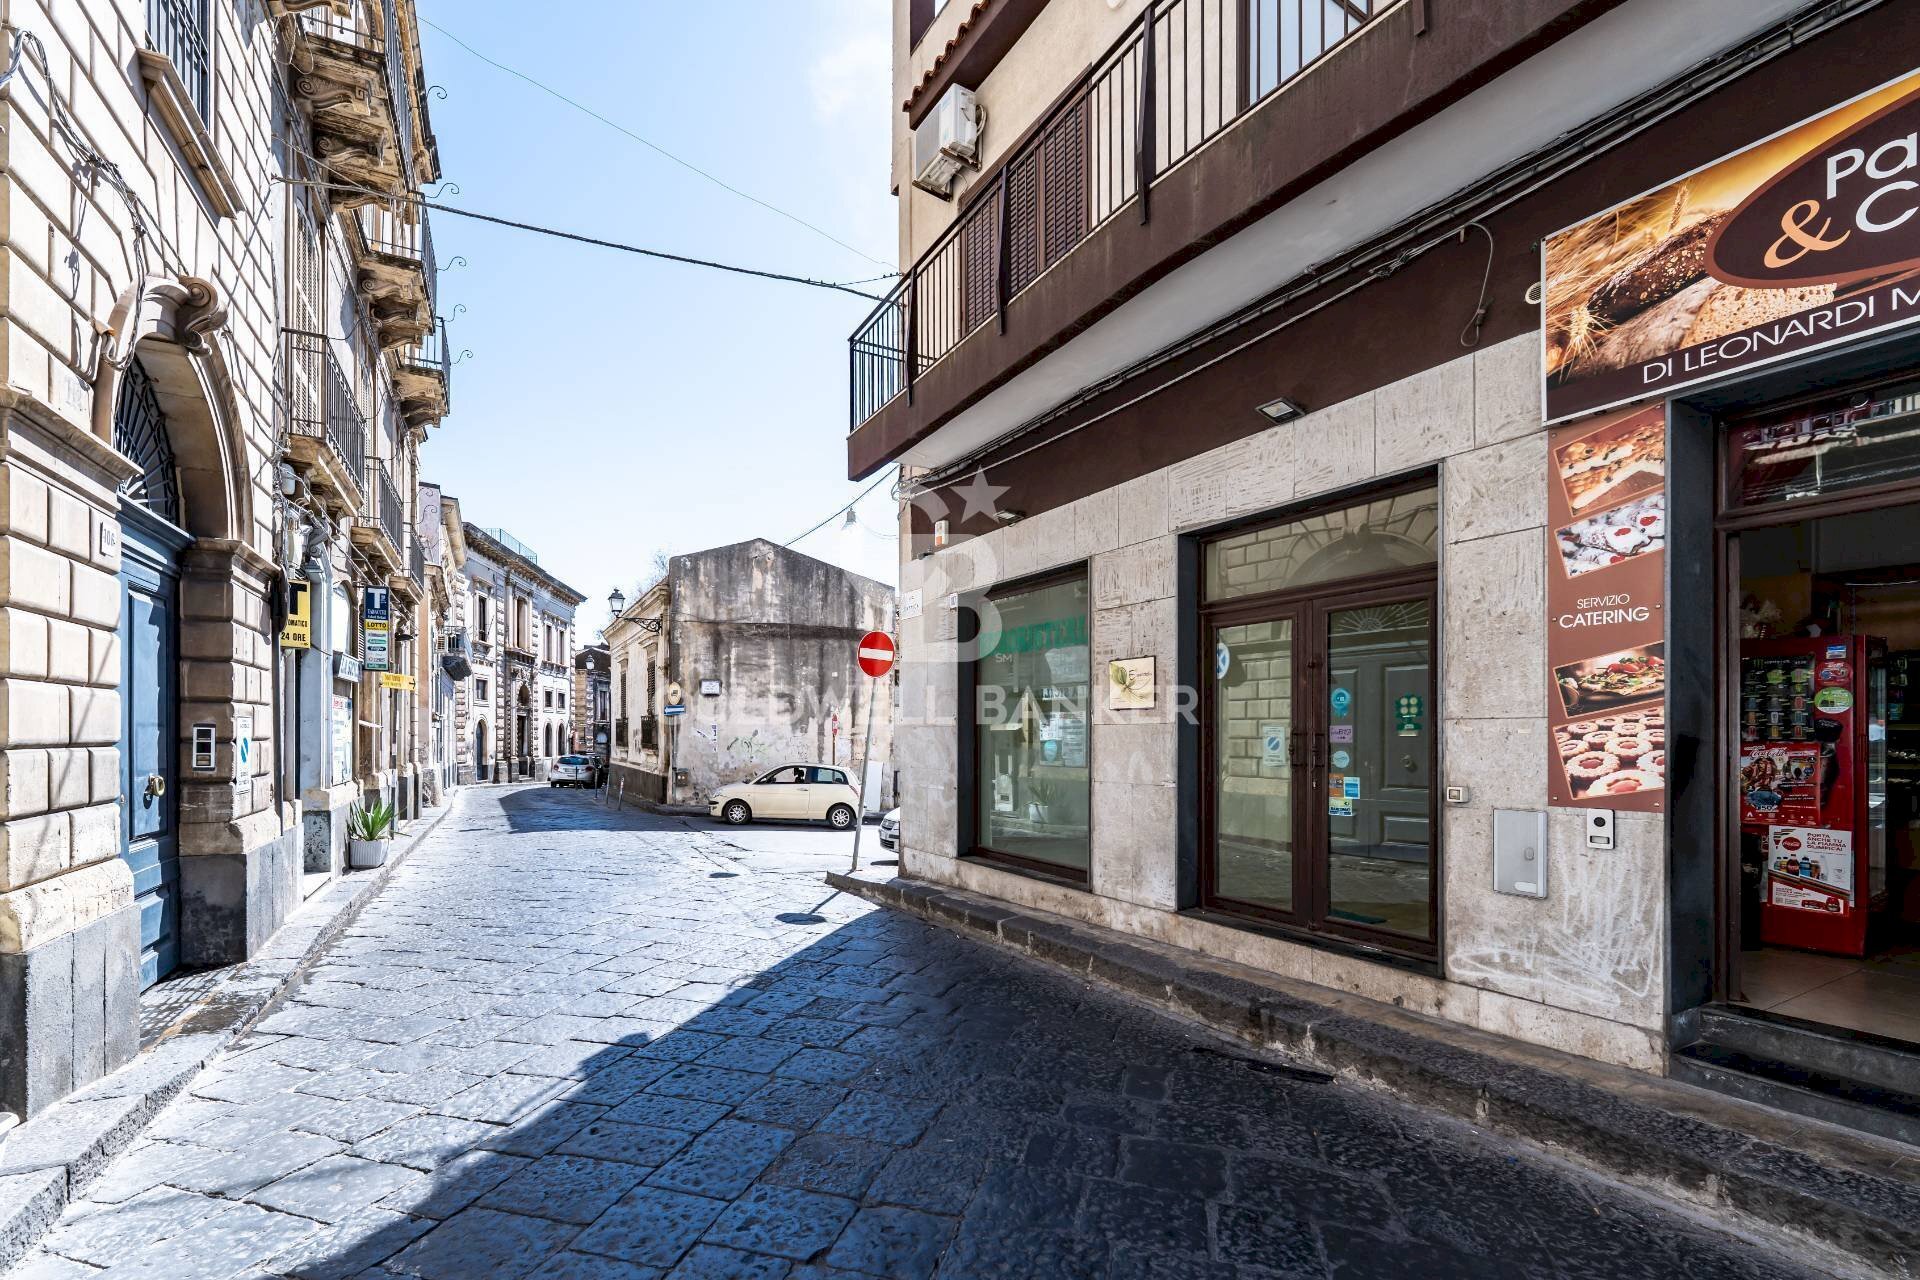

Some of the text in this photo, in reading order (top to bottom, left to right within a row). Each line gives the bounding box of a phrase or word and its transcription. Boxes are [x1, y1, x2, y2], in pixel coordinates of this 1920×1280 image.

[1827, 132, 1918, 200] Pa
[1763, 180, 1920, 269] & C
[1643, 358, 1673, 384] DI
[1685, 295, 1875, 372] LEONARDI
[1577, 593, 1630, 609] SERVIZIO
[287, 619, 308, 628] OMATICO
[1559, 606, 1649, 628] CATERING
[281, 632, 306, 641] 24 ORE
